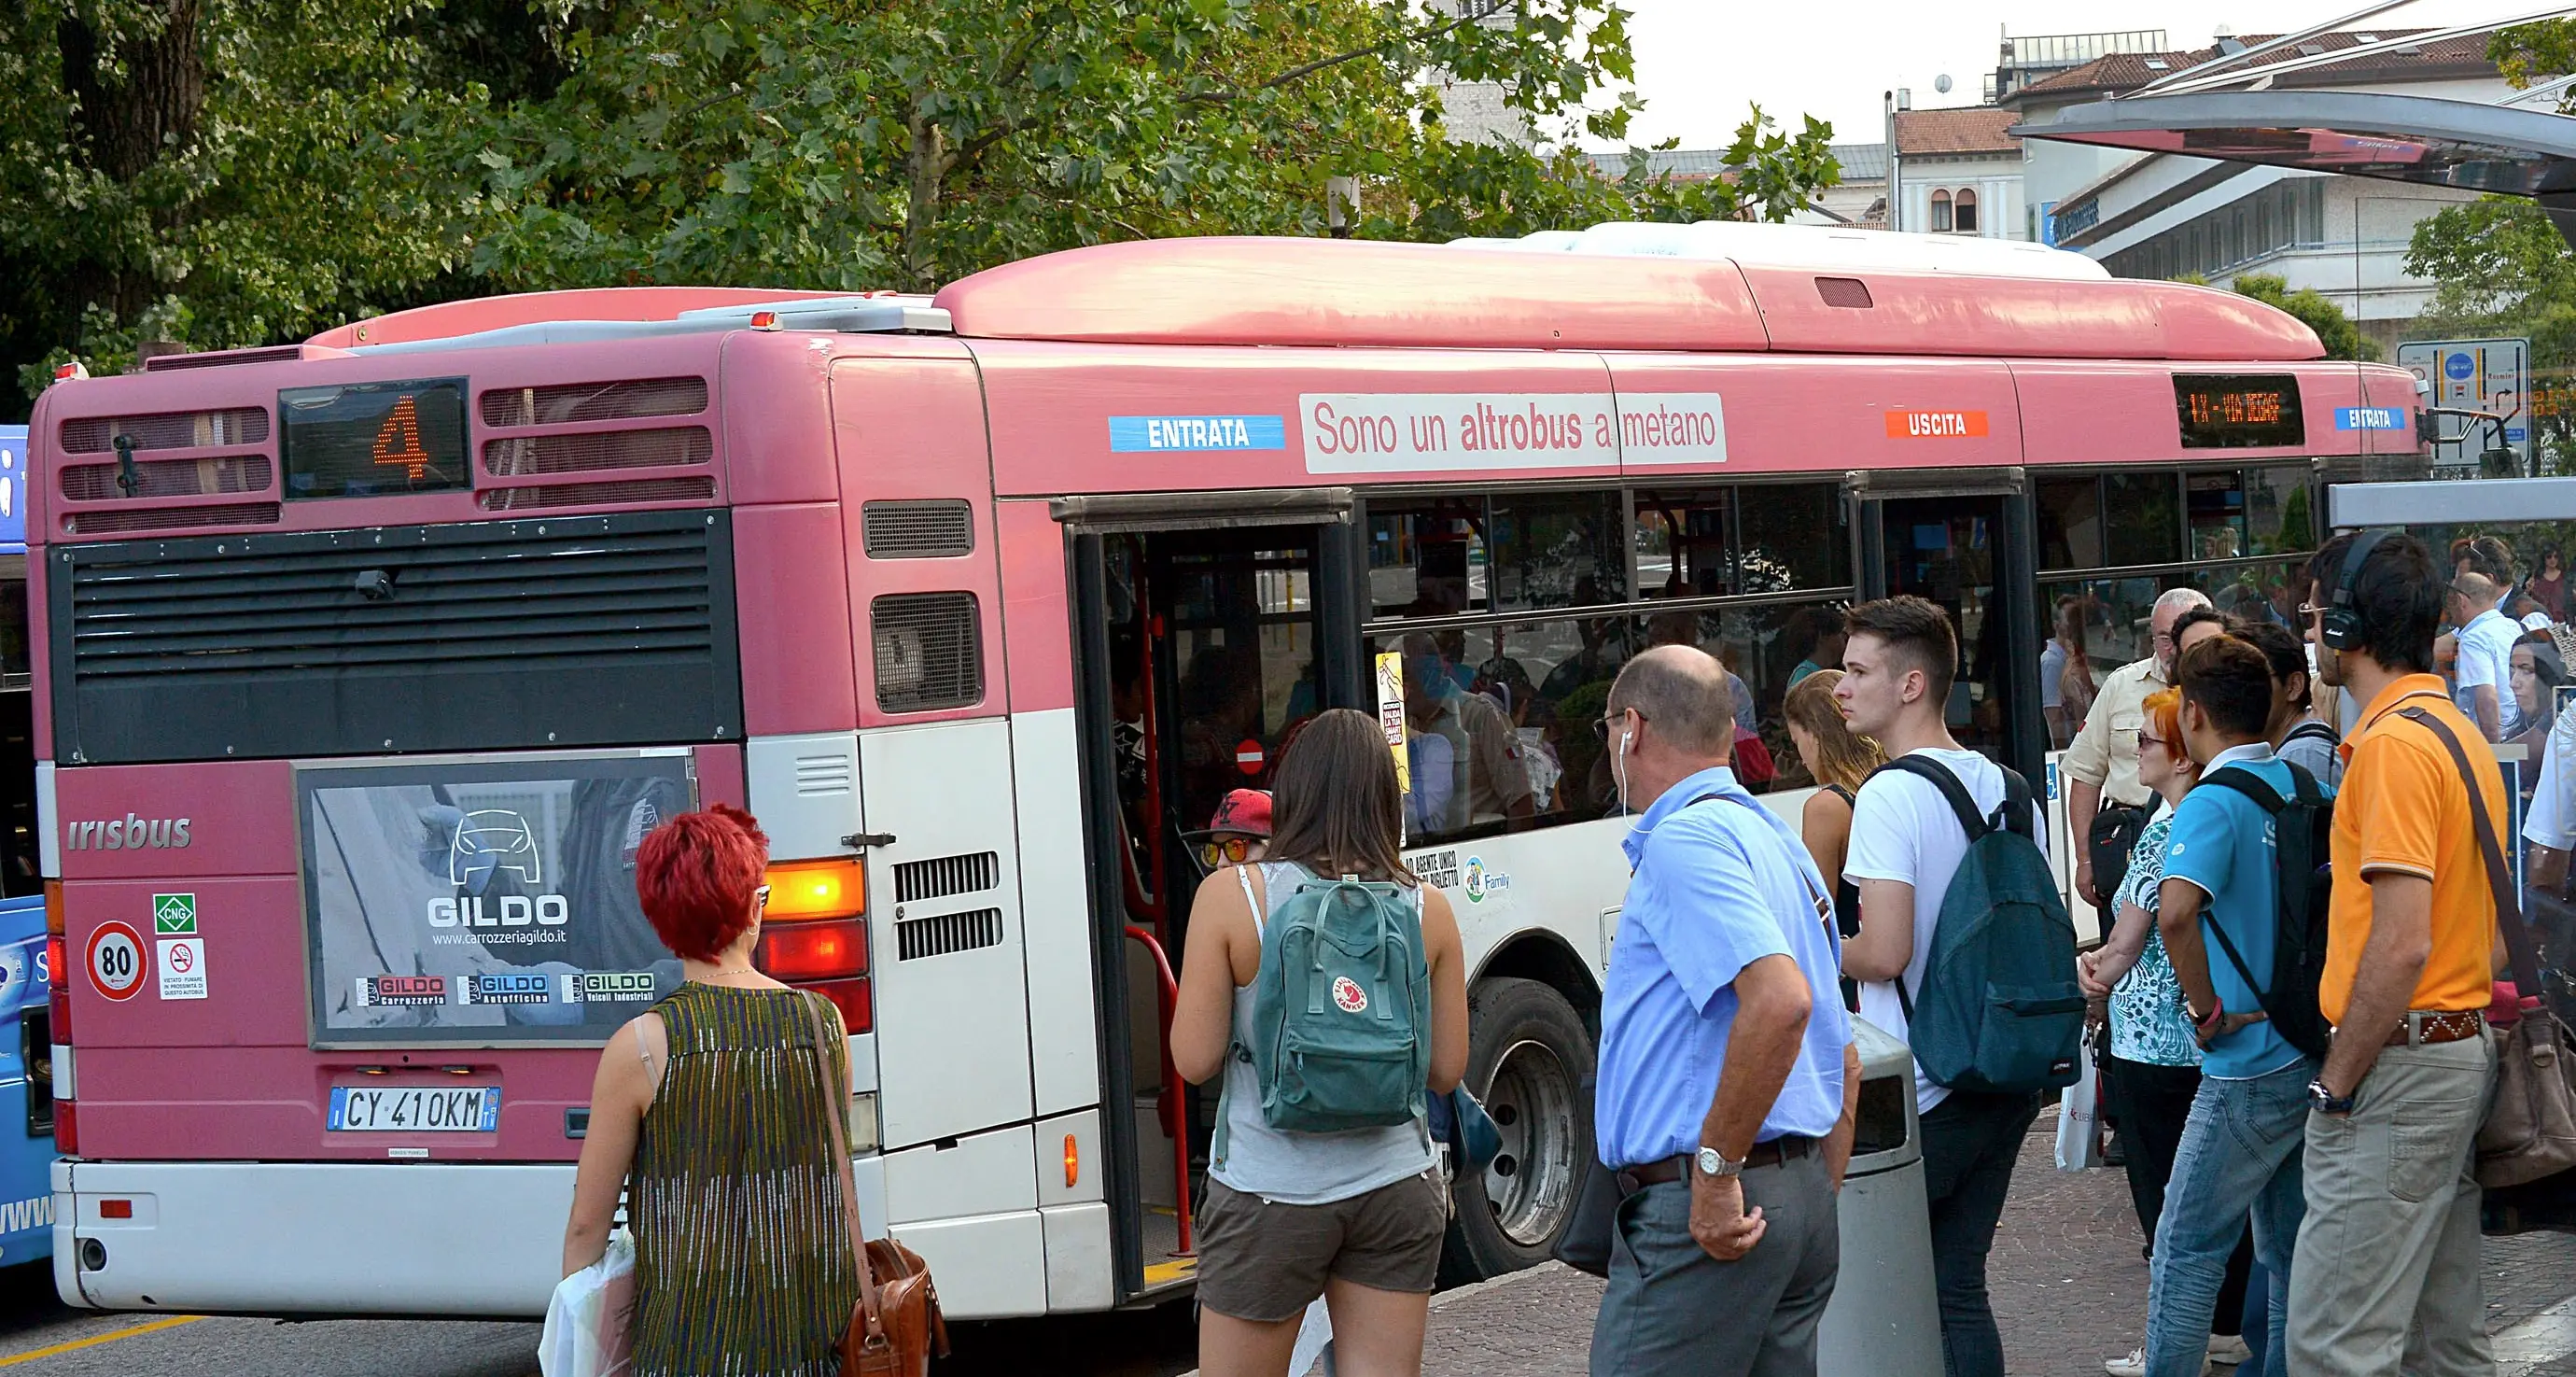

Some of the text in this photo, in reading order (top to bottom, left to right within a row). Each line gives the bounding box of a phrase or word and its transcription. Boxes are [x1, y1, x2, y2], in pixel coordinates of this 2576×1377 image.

[1908, 413, 1967, 436] USCITA
[2348, 409, 2391, 429] ENTRATA
[1147, 419, 1250, 448] ENTRATA
[1314, 401, 1716, 455] Sono un altrobus a metano
[373, 395, 427, 479] 4
[1385, 726, 1402, 735] SMART
[1416, 853, 1437, 875] AGENTE
[1438, 850, 1457, 870] UNICO
[1485, 872, 1510, 889] Family
[164, 907, 186, 920] CNG
[427, 894, 568, 928] GILDO
[432, 930, 567, 946] www.carrozzeriagildo.it
[102, 946, 131, 976] 80
[381, 978, 444, 993] GILDO
[482, 977, 547, 991] GILDO
[586, 975, 653, 990] GILDO
[381, 995, 444, 1005] Carrozzeria
[483, 993, 549, 1004] Autofficina
[586, 991, 654, 1002] Veicoli Industriali
[347, 1091, 383, 1127] CY
[390, 1091, 482, 1127] 410KM
